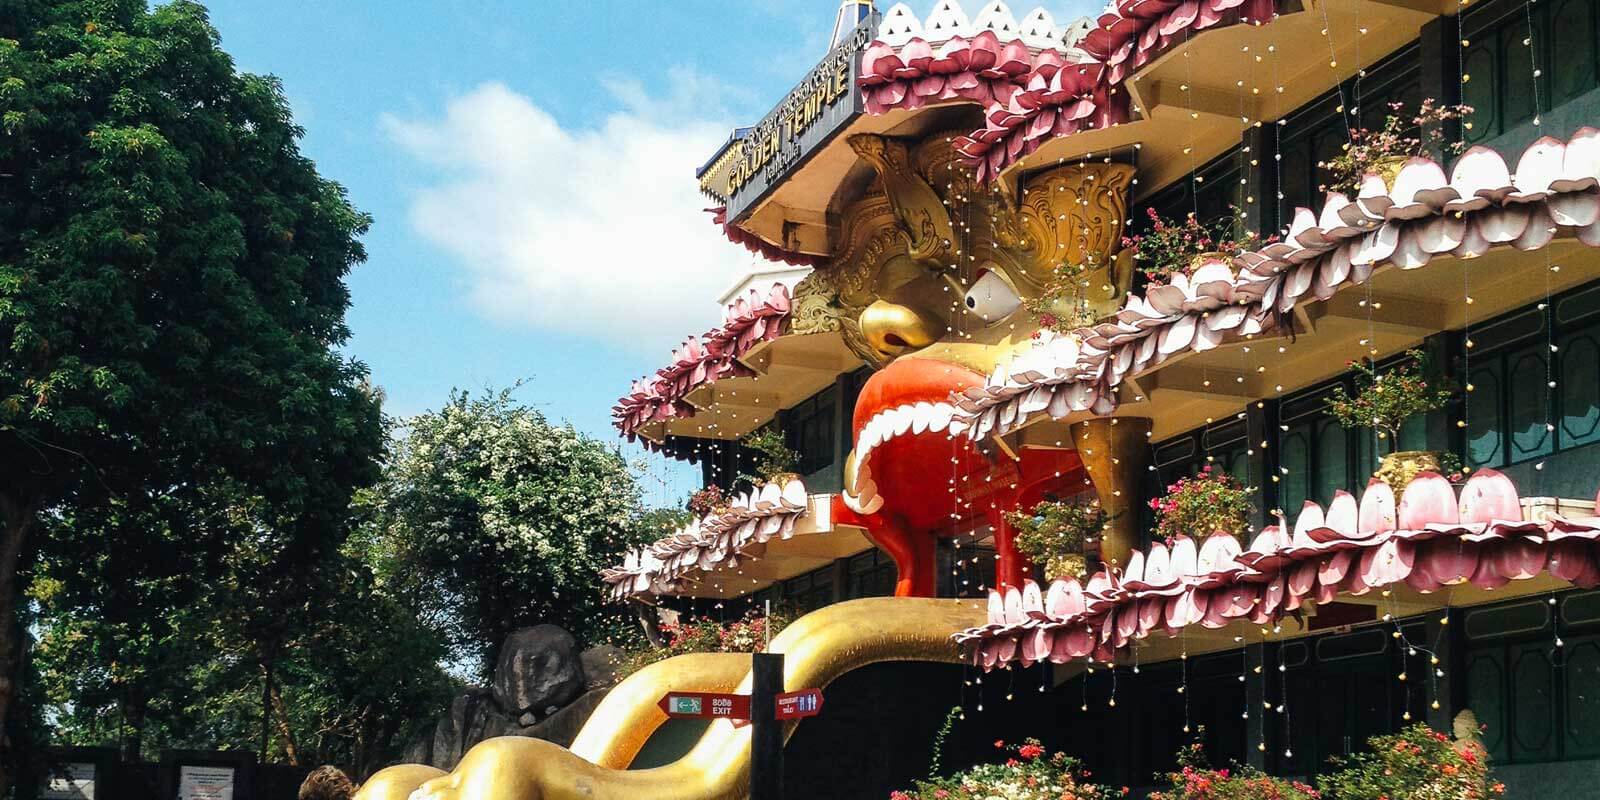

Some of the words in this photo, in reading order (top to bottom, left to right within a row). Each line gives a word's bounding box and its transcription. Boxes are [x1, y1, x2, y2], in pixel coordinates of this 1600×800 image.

[727, 127, 781, 196] GOLDEN
[785, 62, 847, 141] TEMPLE
[712, 707, 732, 715] EXIT
